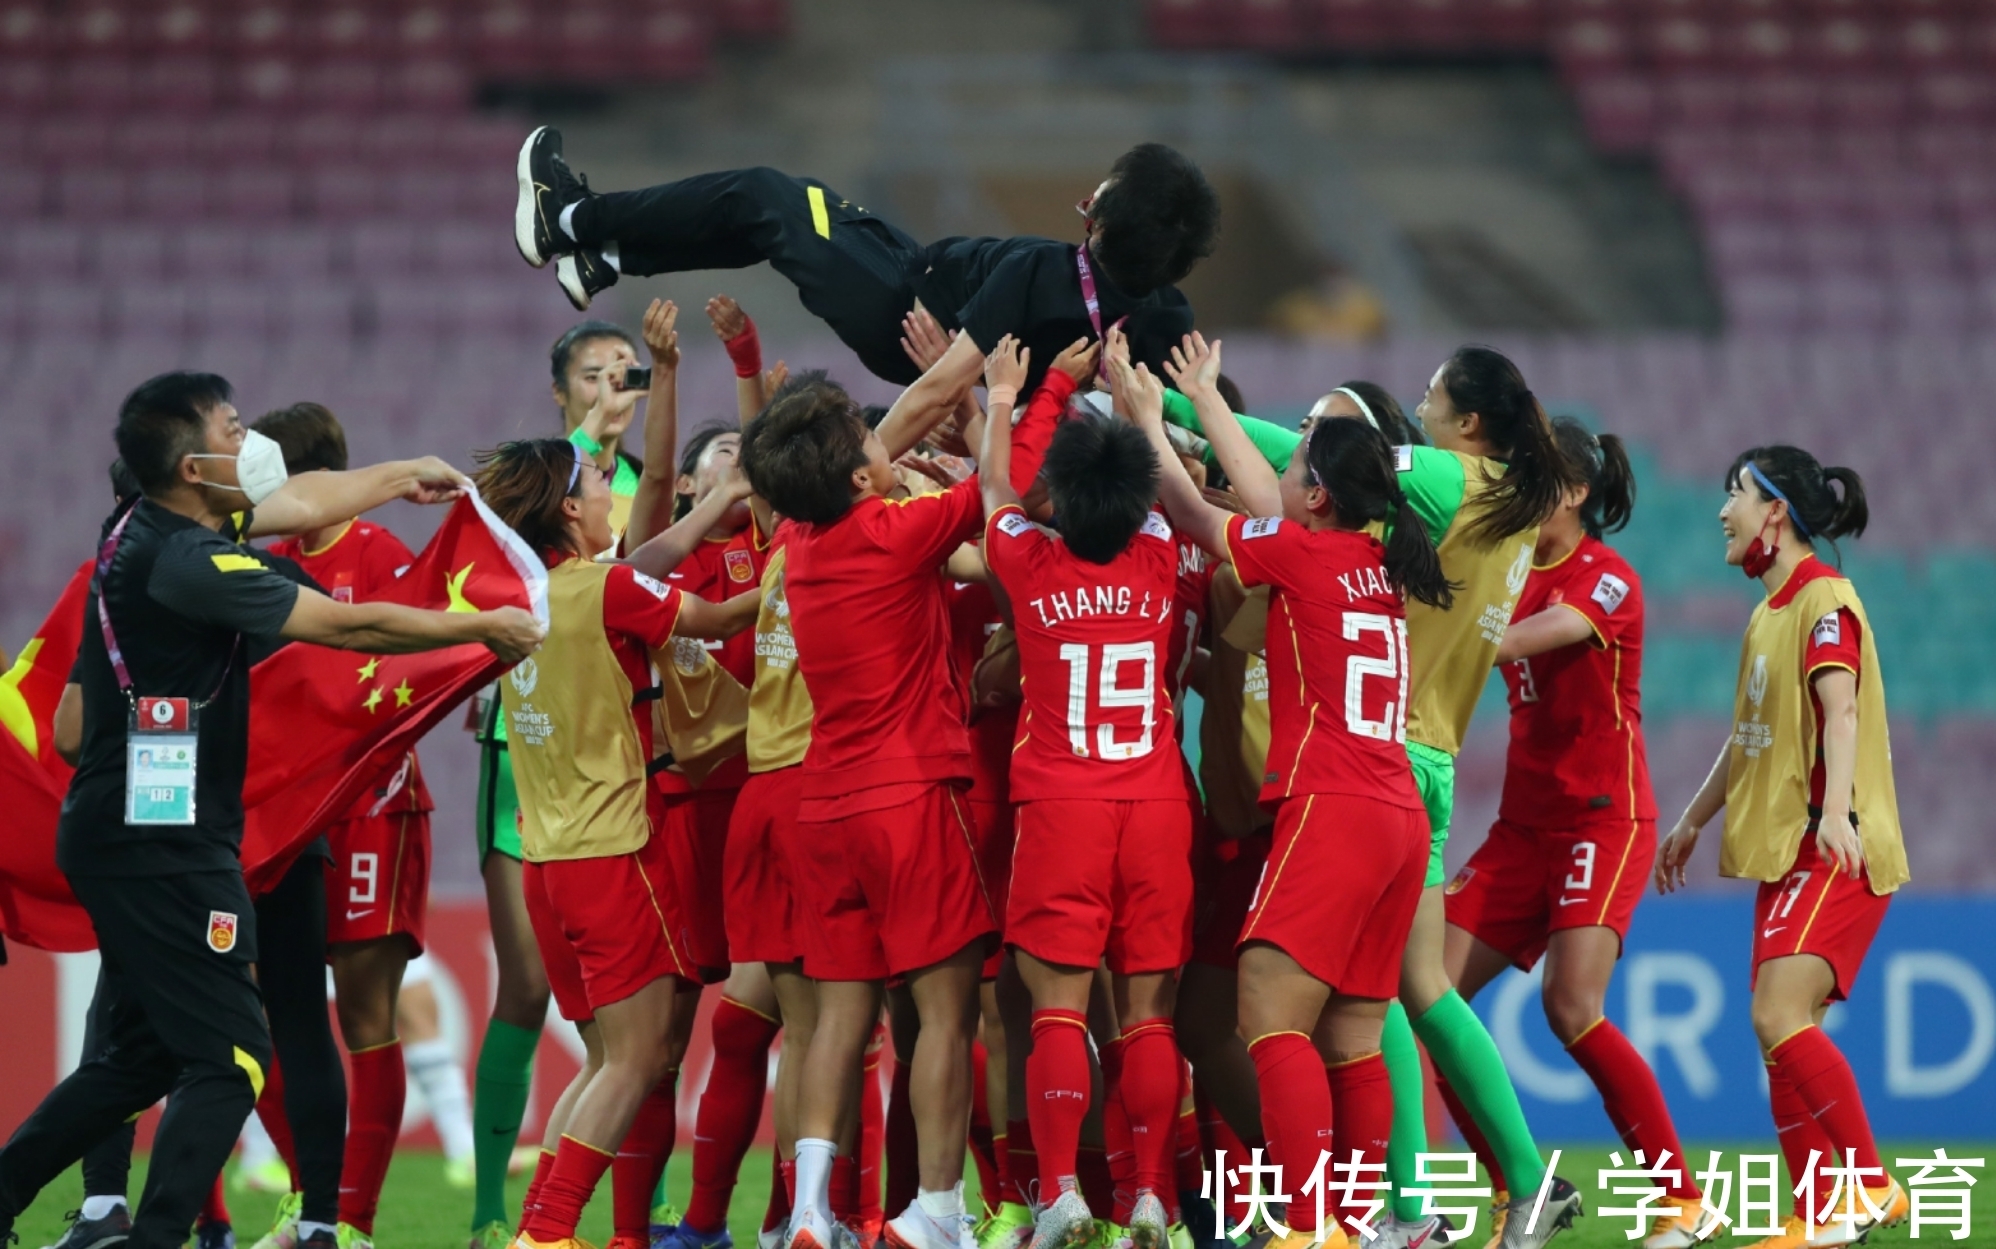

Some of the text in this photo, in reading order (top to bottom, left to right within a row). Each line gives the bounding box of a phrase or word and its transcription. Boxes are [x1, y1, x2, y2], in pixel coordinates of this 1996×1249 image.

[1030, 585, 1131, 628] ZHANG
[1058, 640, 1157, 761] 19
[1514, 657, 1540, 703] 3
[159, 703, 167, 716] 6
[349, 852, 378, 904] 9
[1565, 841, 1596, 890] 3
[1767, 870, 1812, 922] 17
[1489, 948, 1996, 1105] CRD
